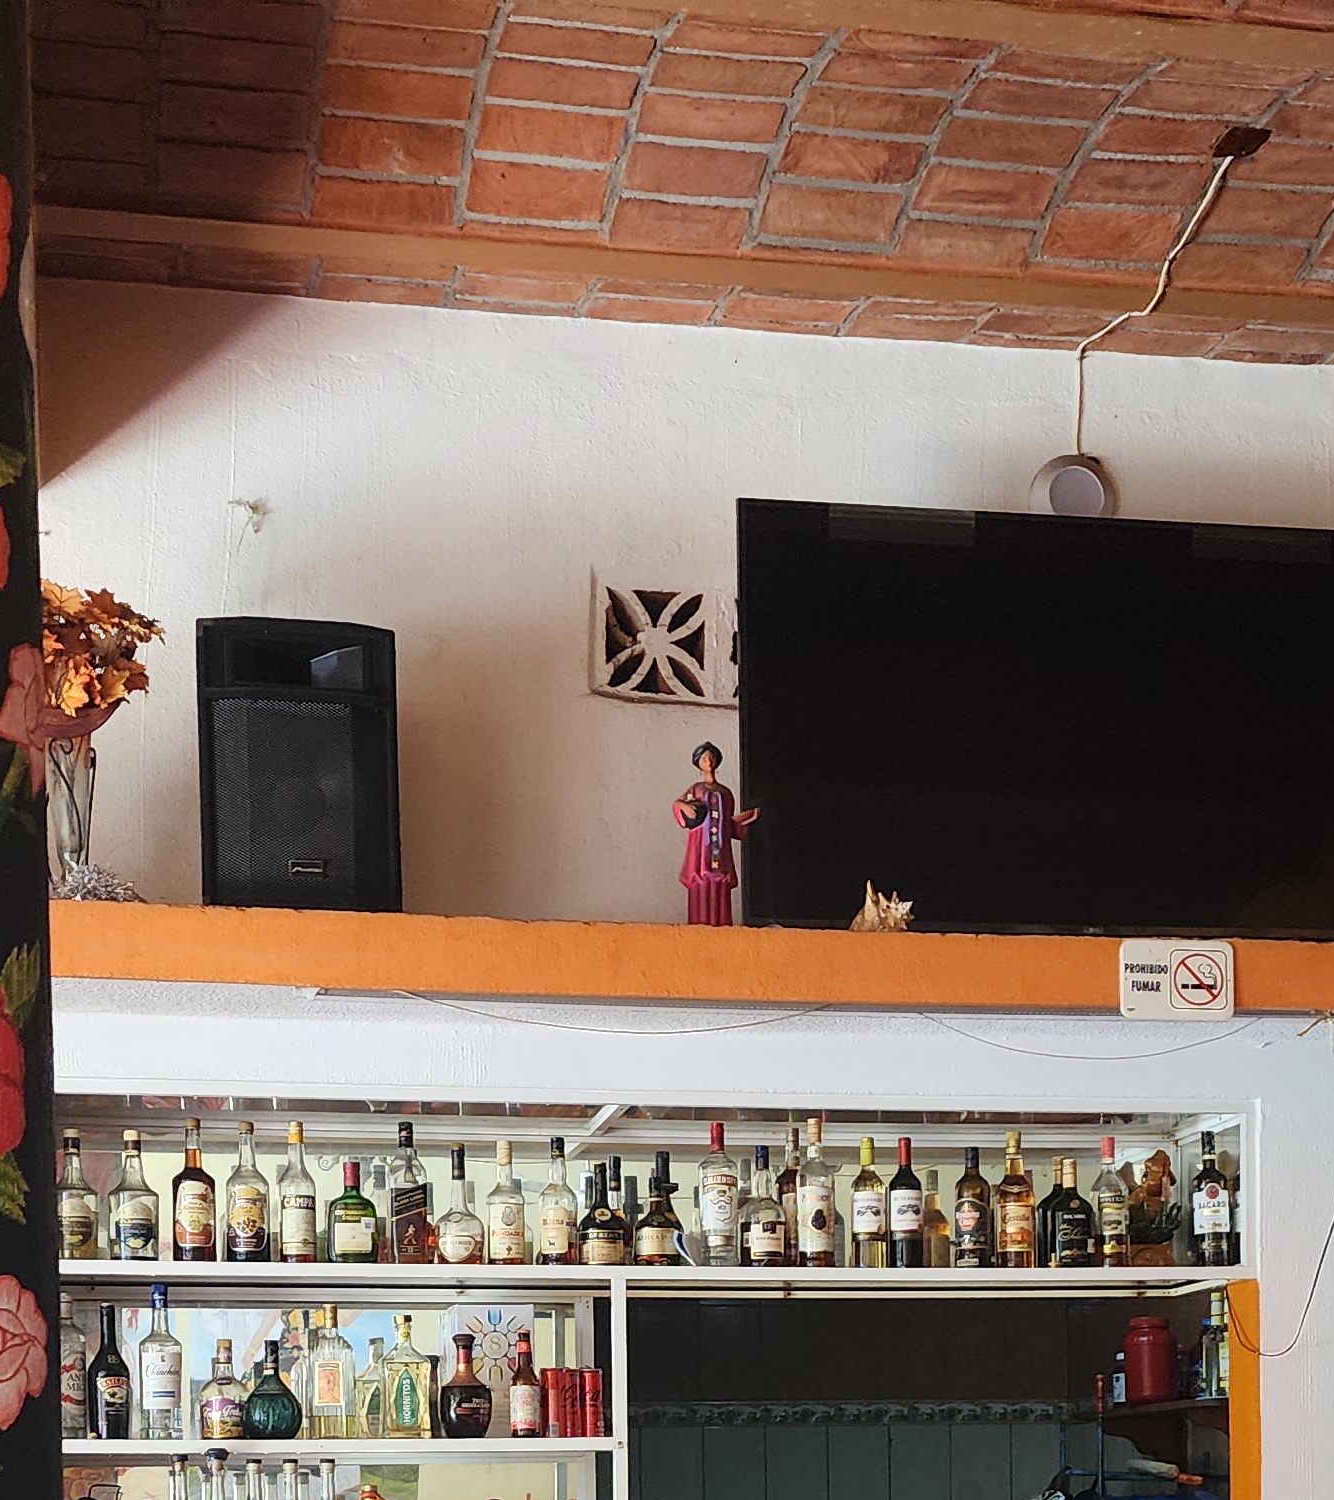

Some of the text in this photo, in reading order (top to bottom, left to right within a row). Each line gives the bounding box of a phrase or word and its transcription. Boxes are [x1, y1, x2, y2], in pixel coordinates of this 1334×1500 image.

[1124, 962, 1169, 975] PROHIBIDO
[1131, 980, 1162, 993] FUMAR
[402, 1378, 411, 1424] HORNITOS
